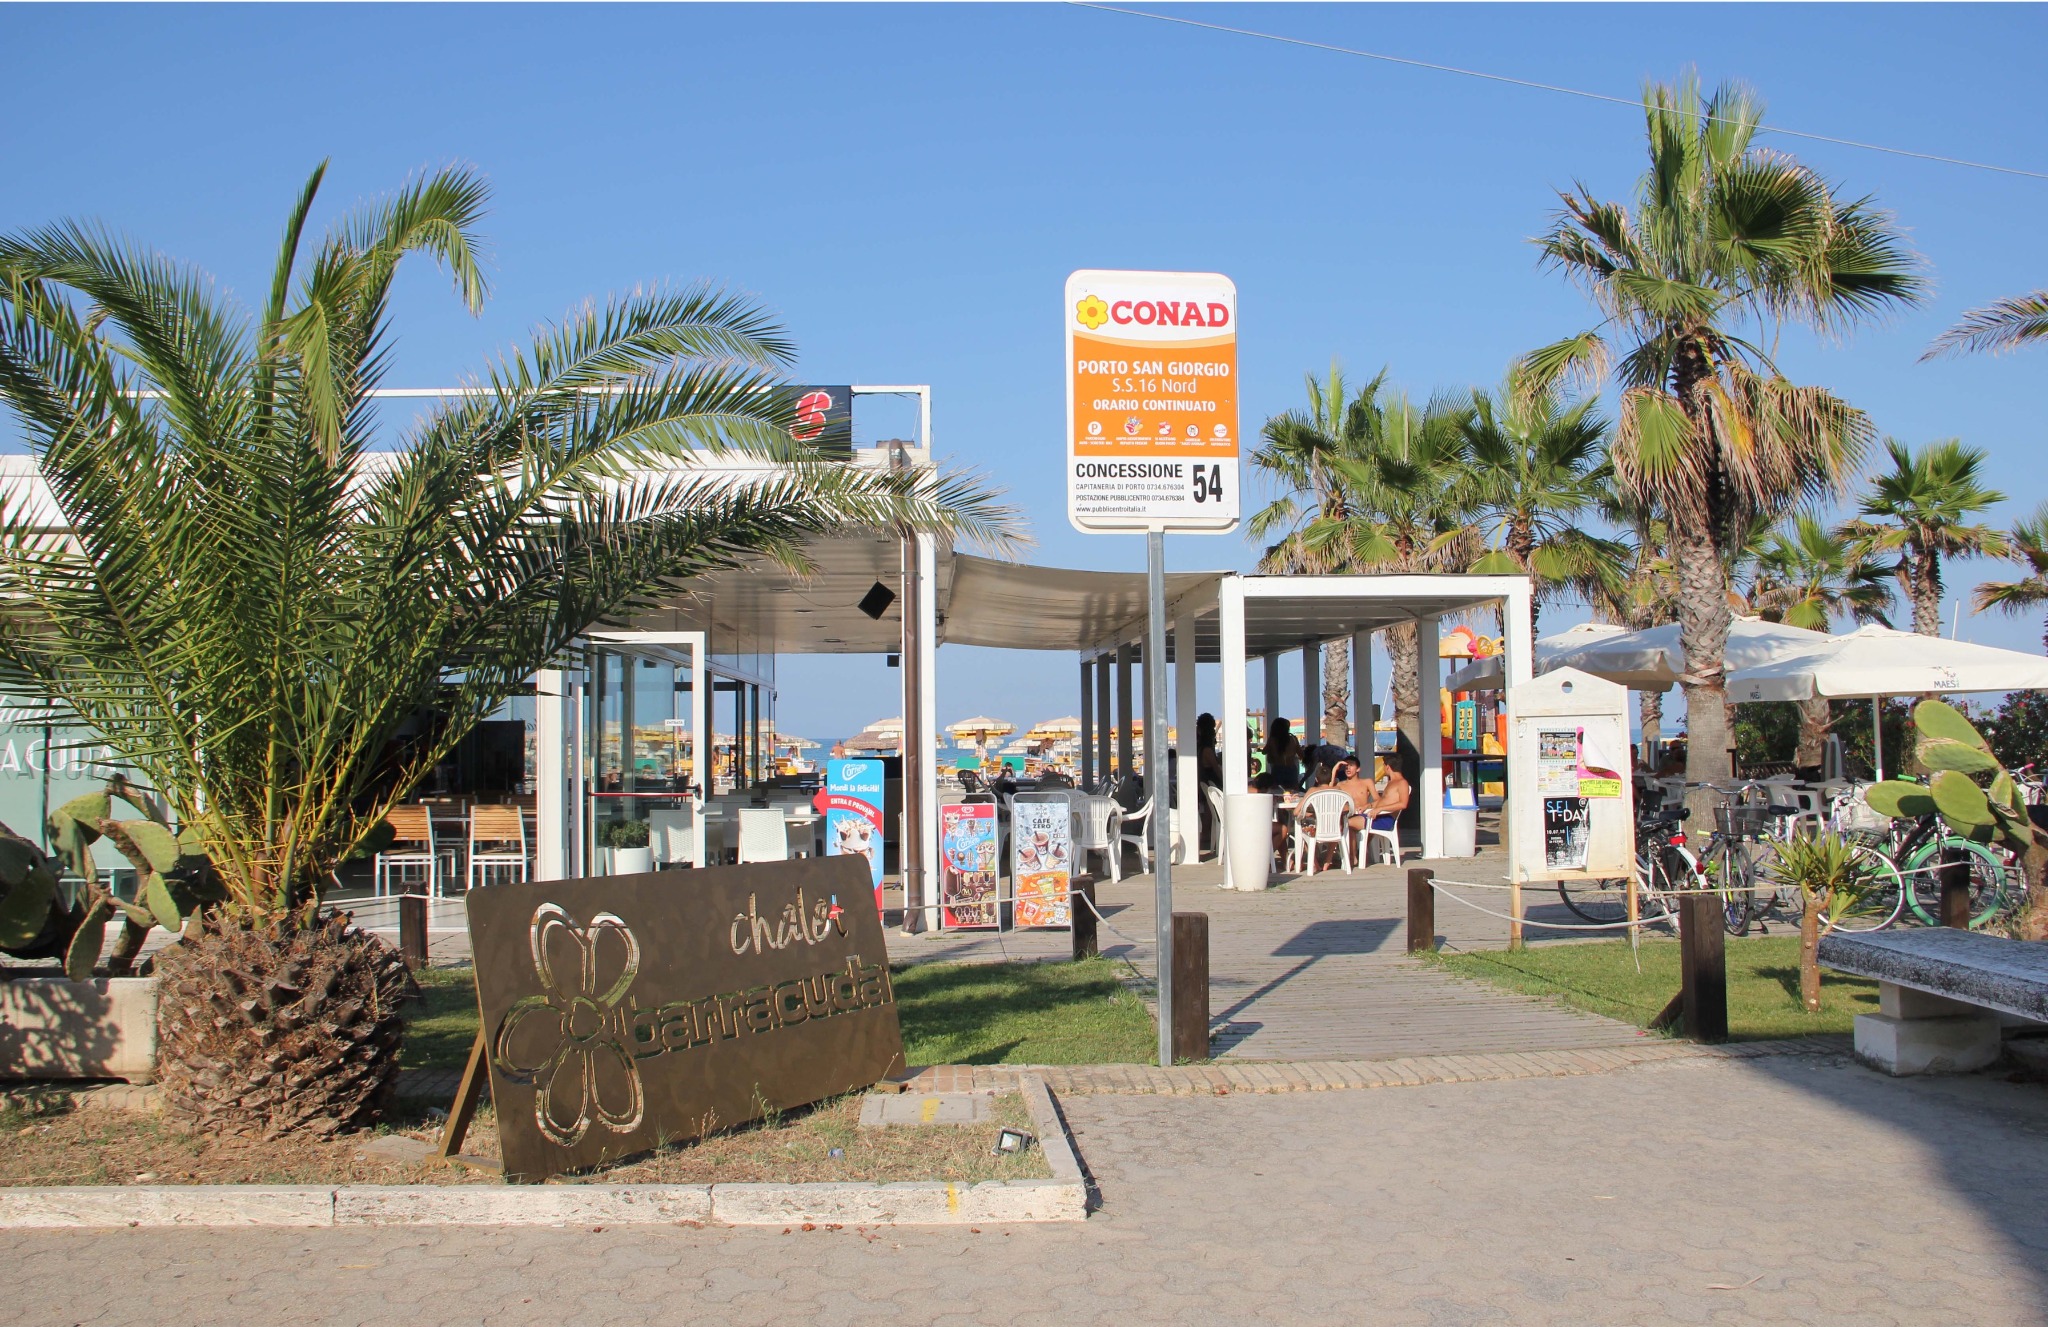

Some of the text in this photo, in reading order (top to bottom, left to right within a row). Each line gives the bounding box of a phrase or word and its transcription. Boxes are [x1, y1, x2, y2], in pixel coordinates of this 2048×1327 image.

[1111, 301, 1229, 327] CONAD
[1078, 360, 1229, 377] PORTO SAN GIORGIO
[1112, 378, 1197, 394] S.S.16 Nord
[1093, 399, 1216, 412] ORARIO CONTINUATO
[1076, 463, 1223, 503] CONCESSIONE 54
[830, 797, 847, 805] ENTRA
[847, 799, 853, 807] E
[1549, 808, 1589, 822] T-DAY
[730, 886, 849, 955] chalet
[620, 954, 895, 1060] barracuda
